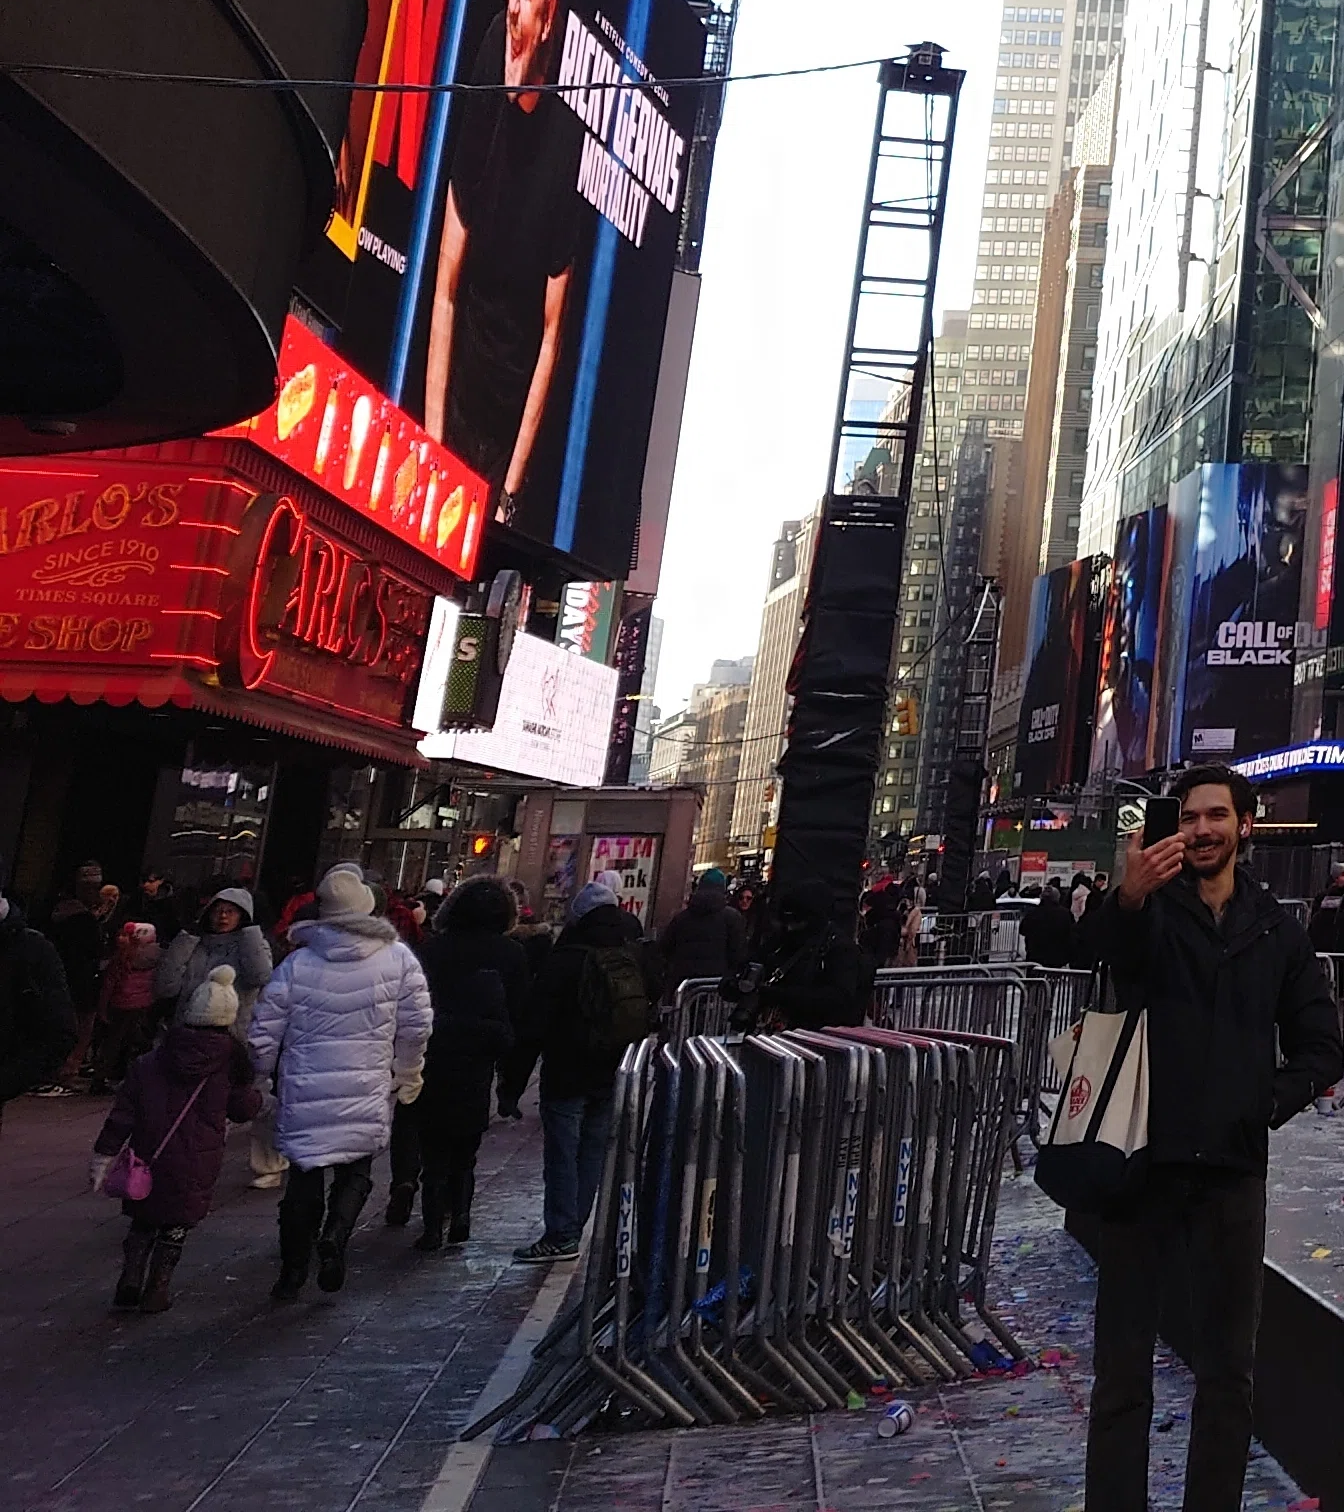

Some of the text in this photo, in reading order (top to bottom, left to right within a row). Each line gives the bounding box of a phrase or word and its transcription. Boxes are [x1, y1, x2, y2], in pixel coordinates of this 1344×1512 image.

[600, 16, 625, 55] NETFLIX
[625, 46, 649, 82] COMEDY
[557, 9, 685, 214] RICKY GERVAIS
[576, 130, 650, 250] MORTALITY
[357, 226, 408, 275] OW PLAYING
[44, 539, 160, 571] SINCE 1910
[16, 588, 161, 607] TIMES SQUARE
[24, 615, 153, 652] SHOP
[1217, 622, 1280, 648] CALL
[1277, 626, 1294, 639] OF
[1207, 649, 1293, 665] BLACK
[595, 839, 653, 858] ATM
[895, 1142, 912, 1223] NYPD
[618, 1187, 632, 1274] NYPD
